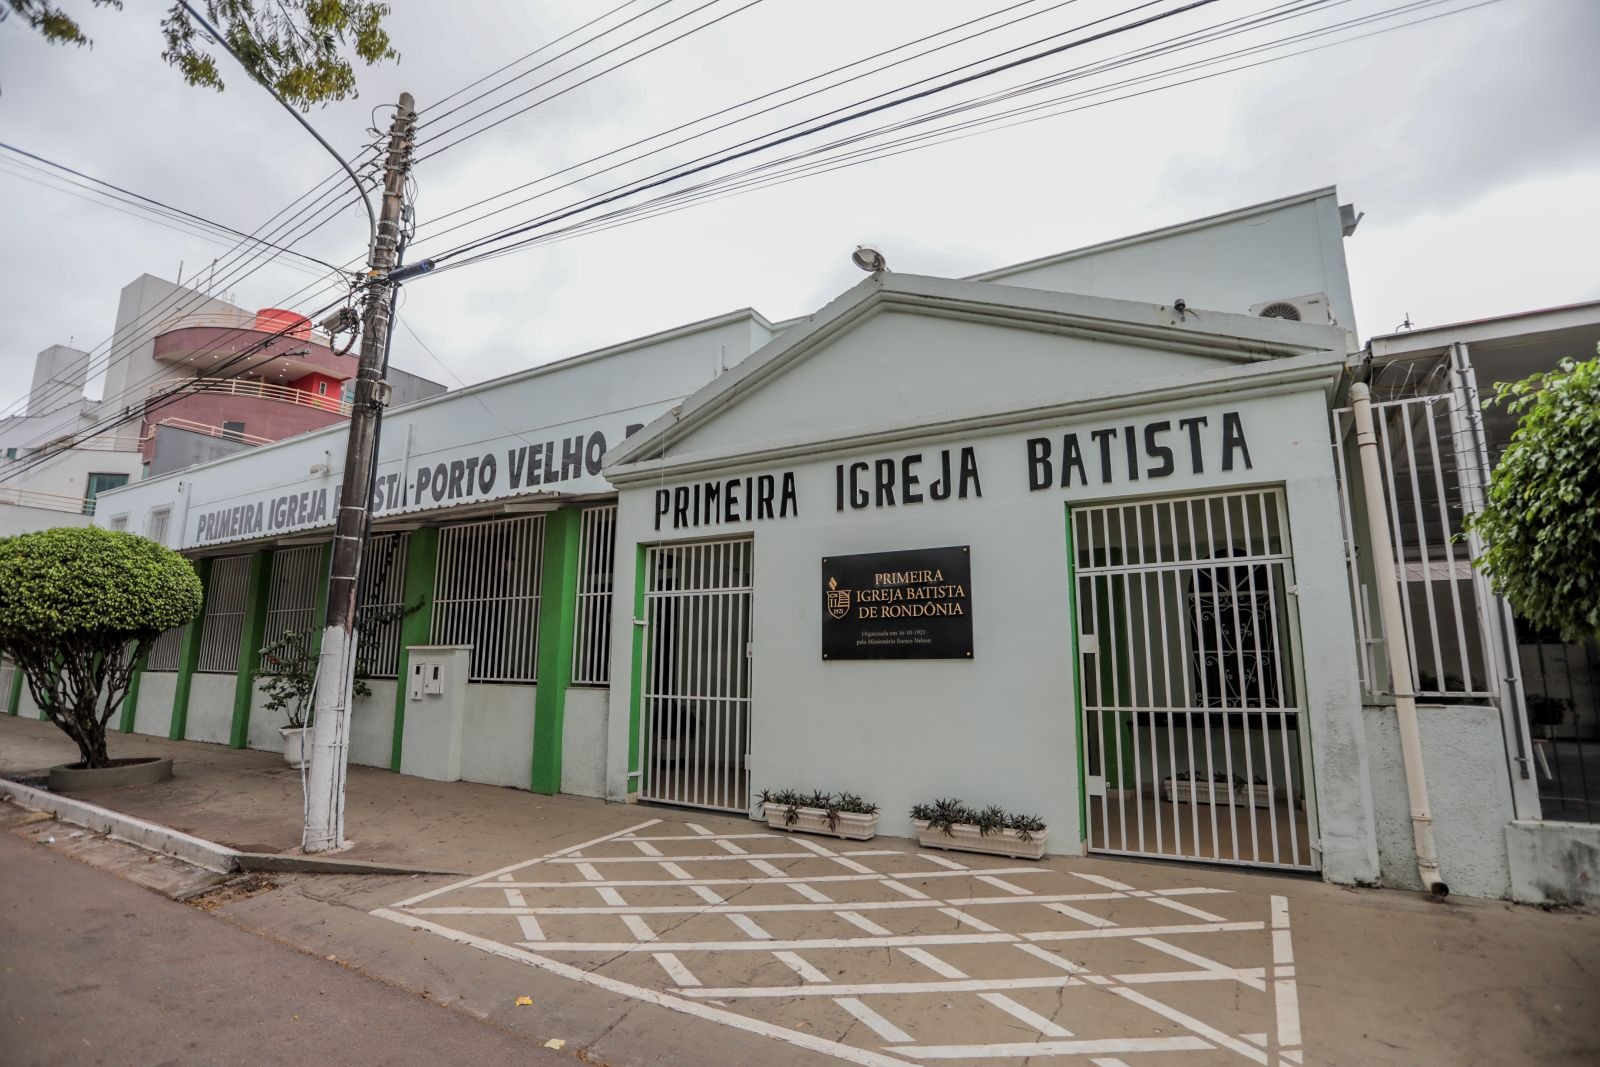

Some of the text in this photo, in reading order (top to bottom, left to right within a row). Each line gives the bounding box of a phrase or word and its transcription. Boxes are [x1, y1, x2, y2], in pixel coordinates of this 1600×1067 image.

[655, 411, 1253, 531] PRIMEIRA IGREJA BATISTA
[196, 501, 263, 542] PRIMEIRA
[267, 488, 327, 530] IGREJA
[414, 453, 497, 505] PORTO
[508, 430, 607, 490] VELHO
[875, 569, 944, 585] PRIMEIRA
[856, 585, 966, 603] IGREJA BATISTA
[859, 602, 964, 619] DE RONDÔNIA
